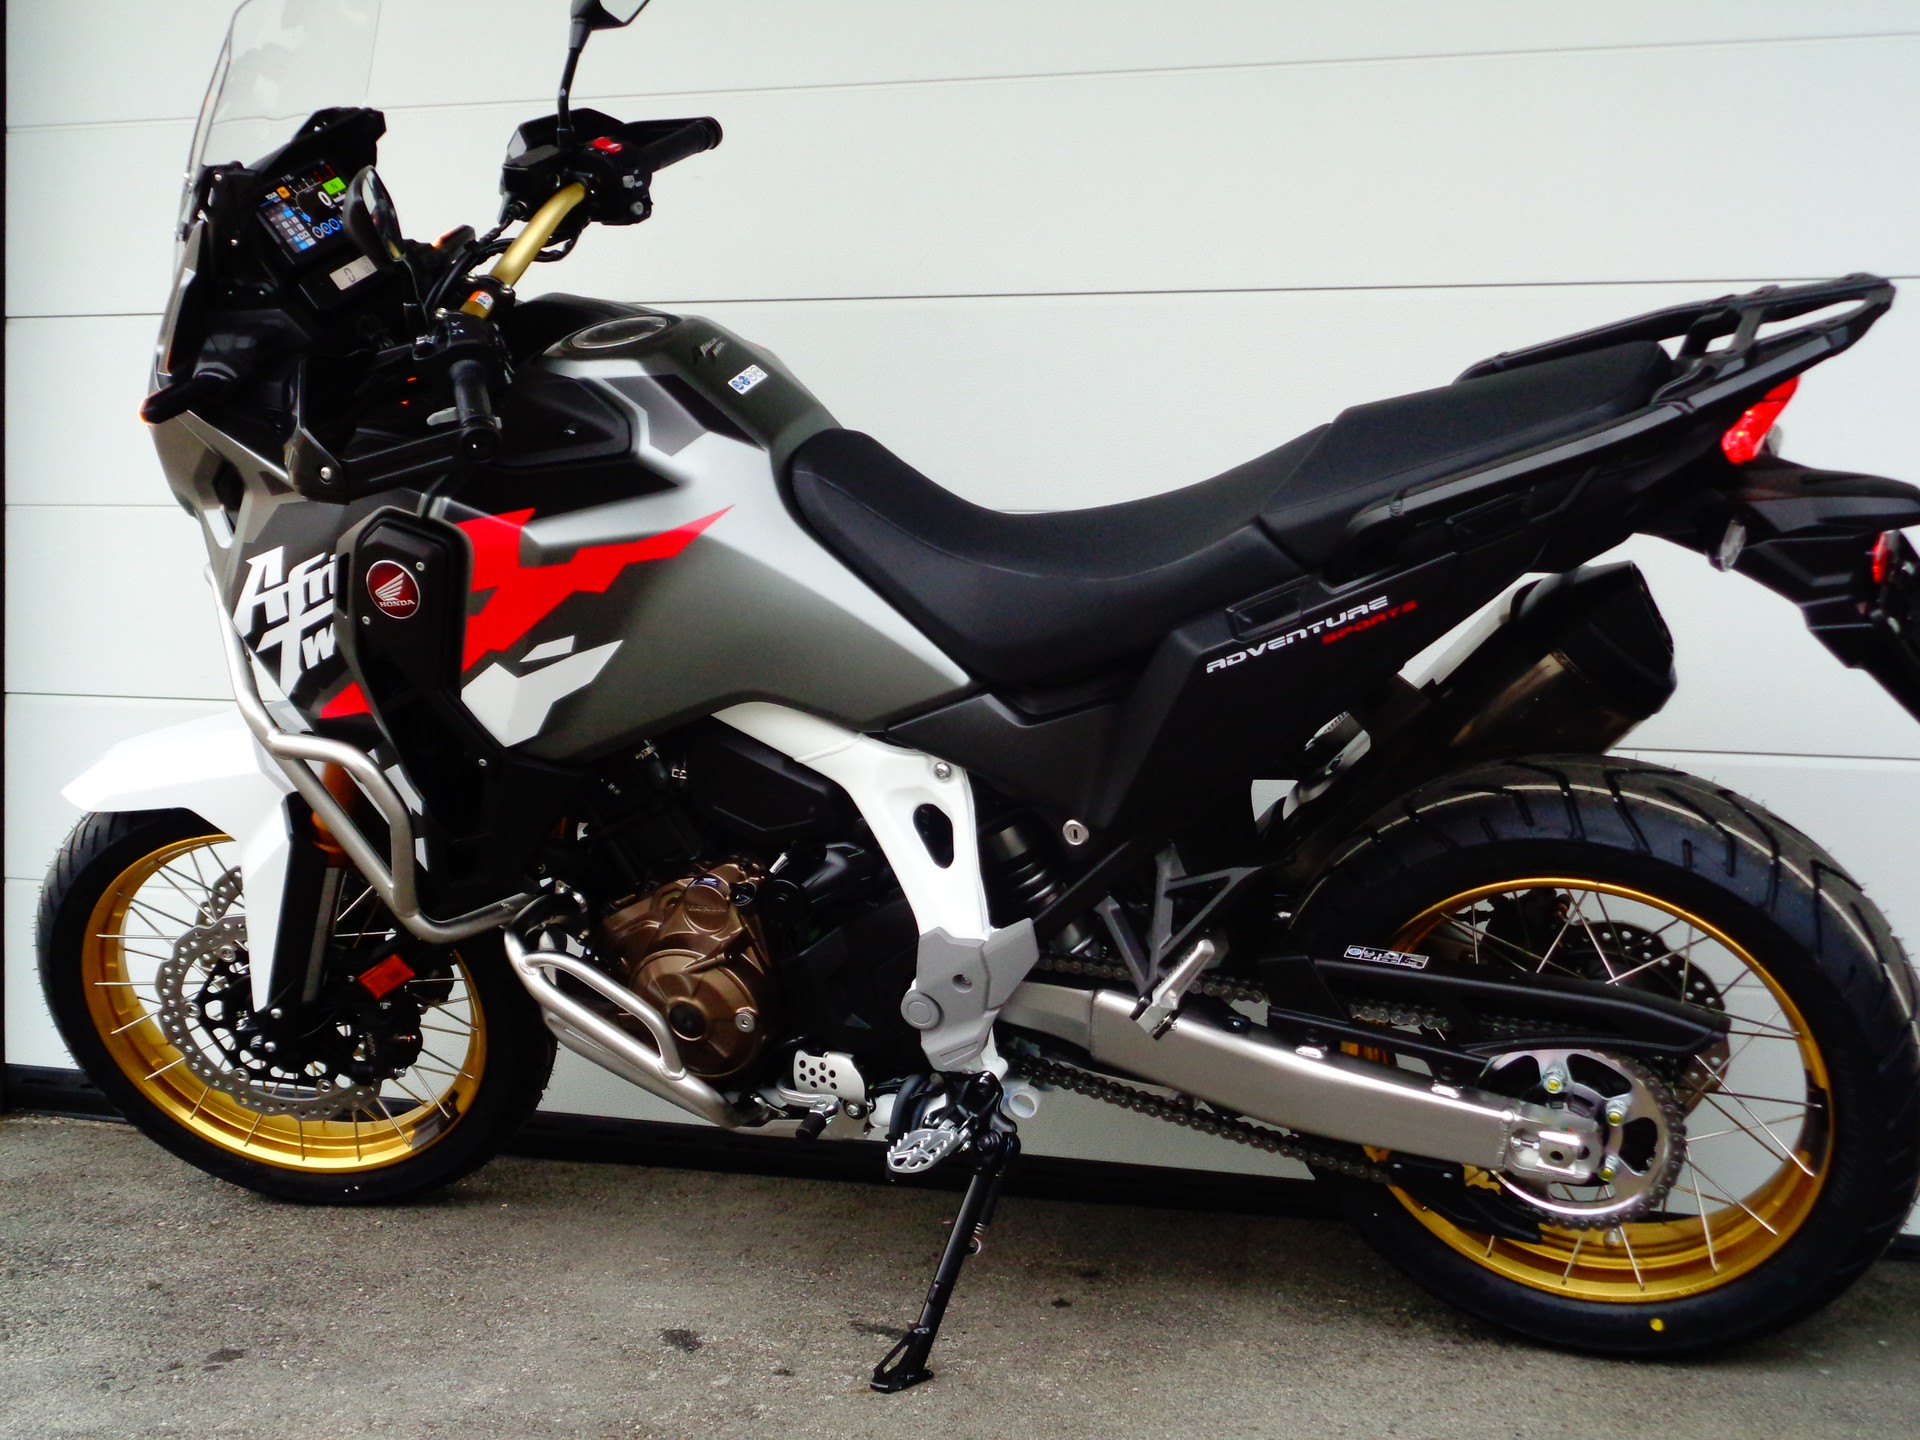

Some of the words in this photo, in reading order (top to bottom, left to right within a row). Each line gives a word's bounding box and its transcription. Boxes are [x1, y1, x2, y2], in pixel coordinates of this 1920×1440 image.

[379, 599, 416, 607] HONDA
[1322, 600, 1418, 644] SPORTS
[1206, 595, 1388, 674] ADVENTURE
